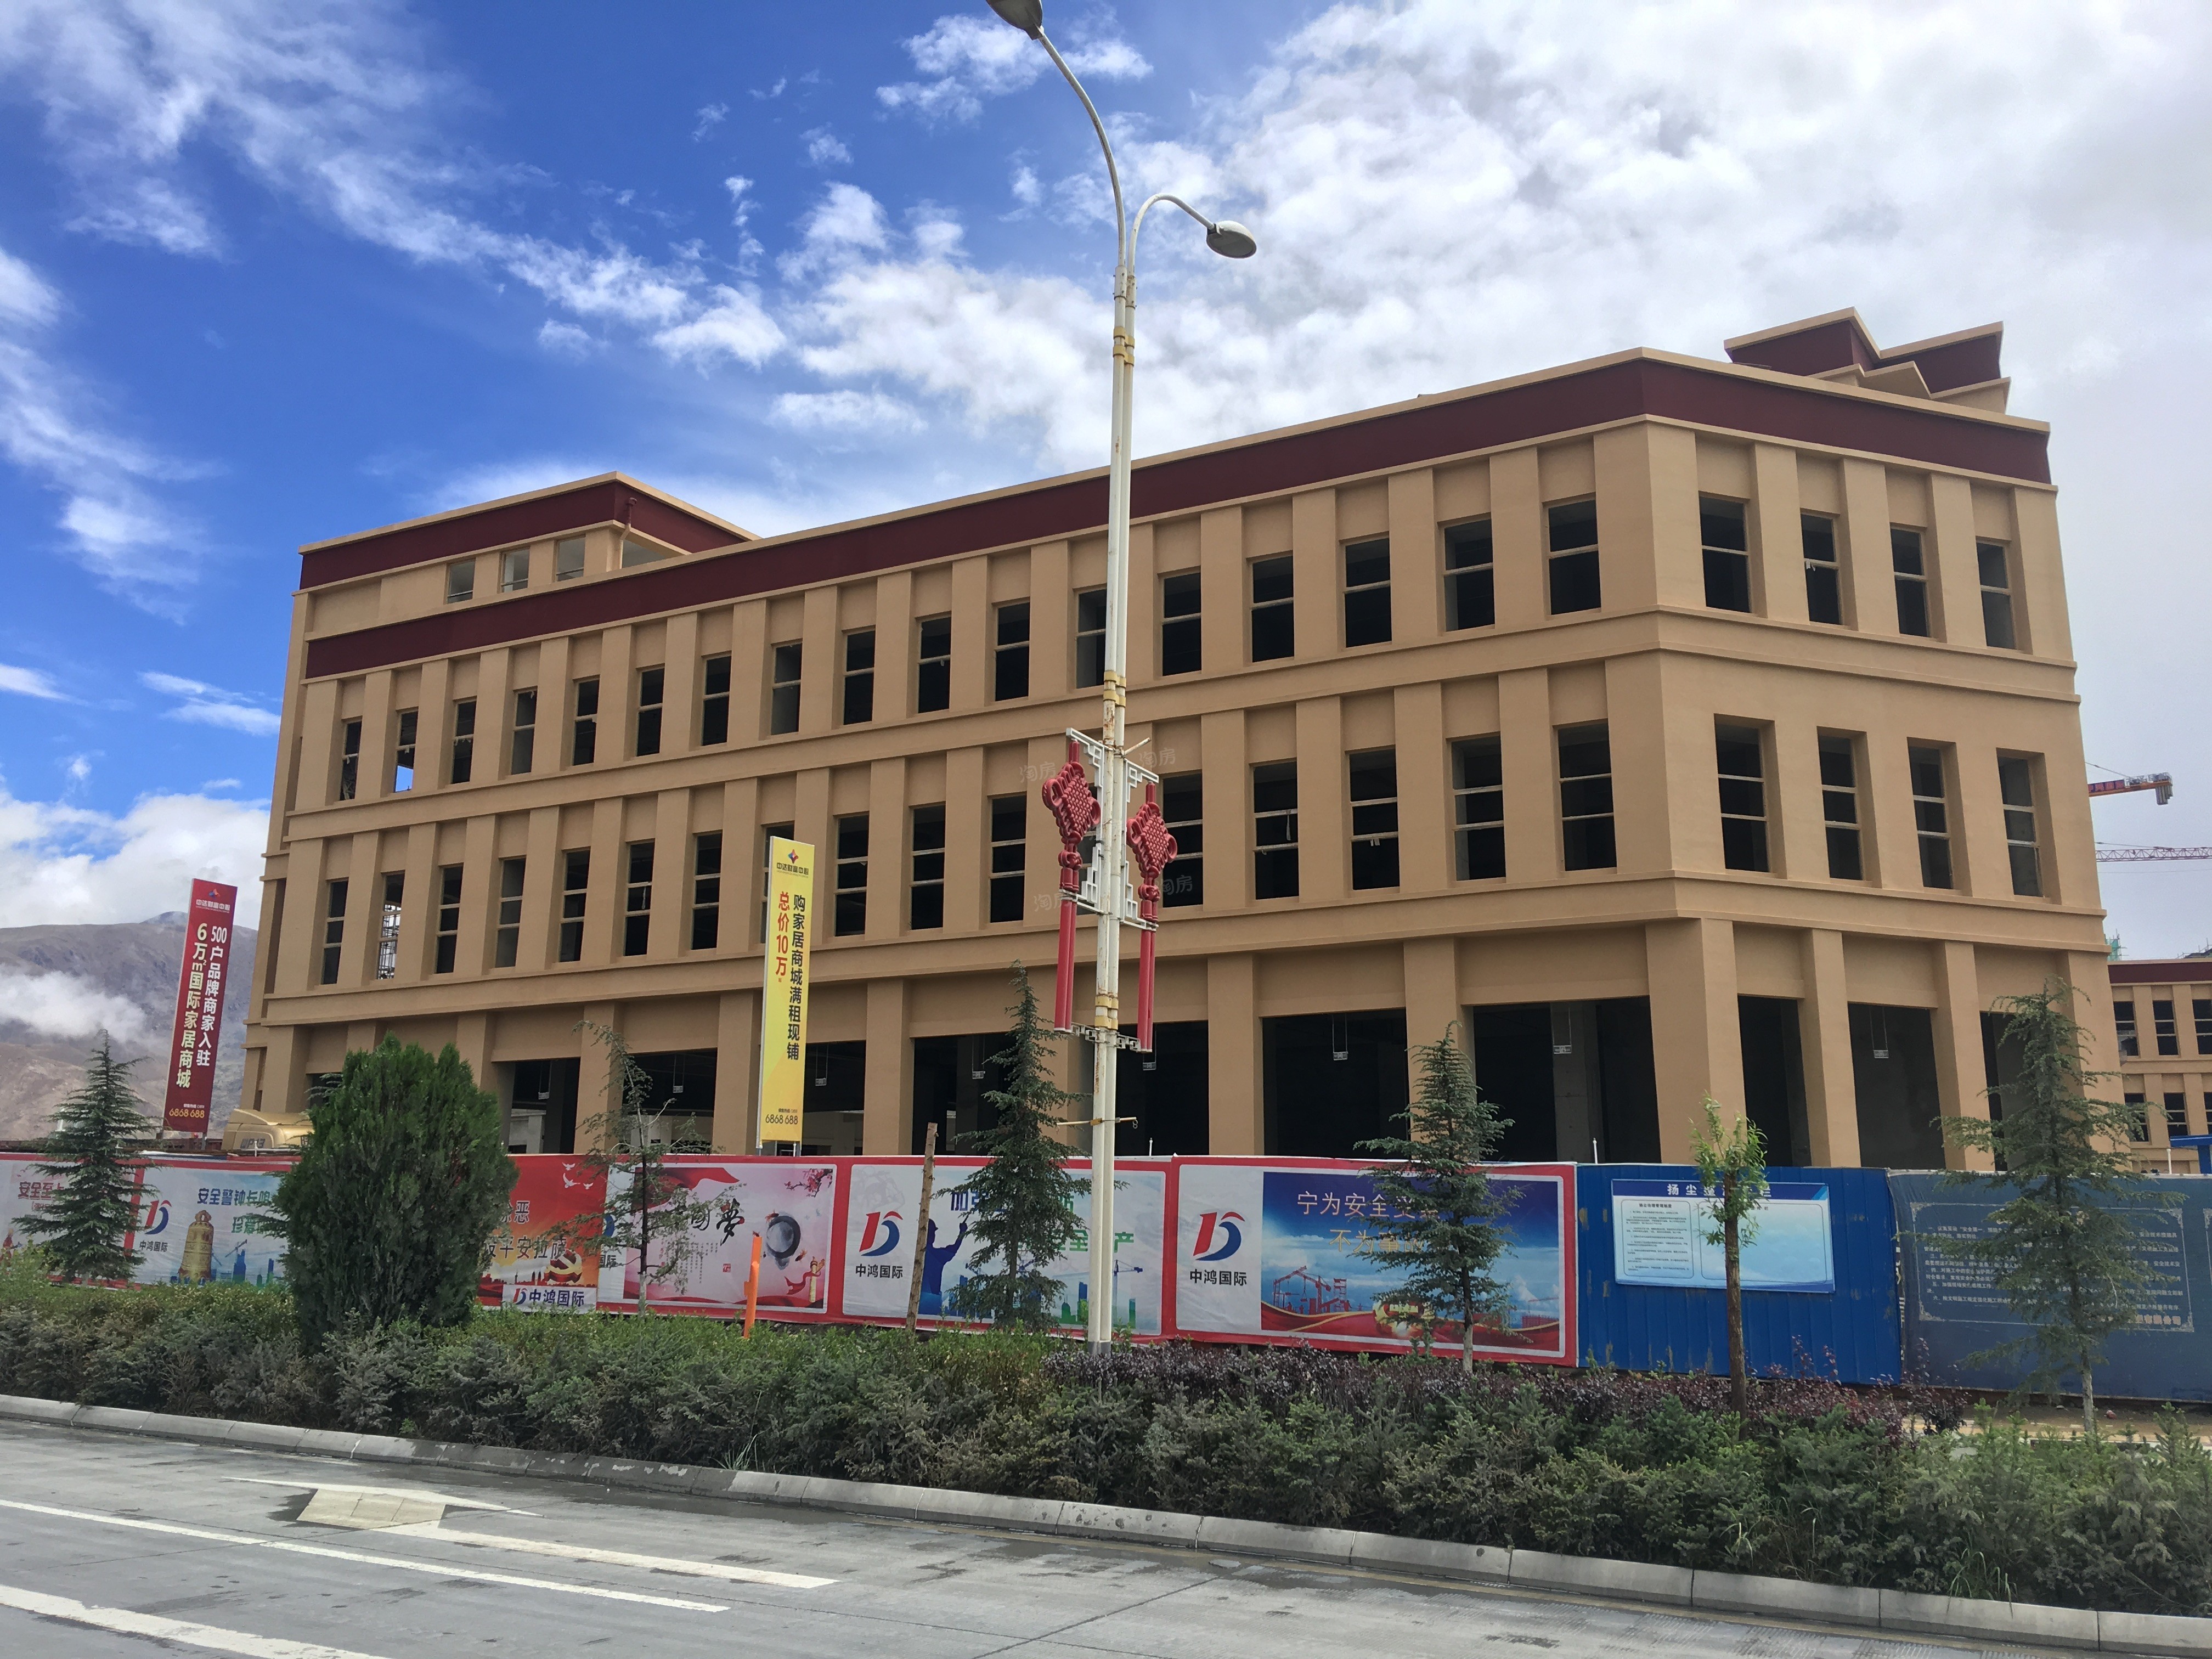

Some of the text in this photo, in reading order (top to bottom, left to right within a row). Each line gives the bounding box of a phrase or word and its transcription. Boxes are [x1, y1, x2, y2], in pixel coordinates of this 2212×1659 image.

[787, 894, 805, 1060] 购家居商城满租现铺
[139, 1240, 168, 1252] 中鸿国际
[855, 1263, 904, 1279] 中鸿国际
[1189, 1269, 1247, 1286] 中鸿国际
[529, 1289, 584, 1307] 中鸿国际
